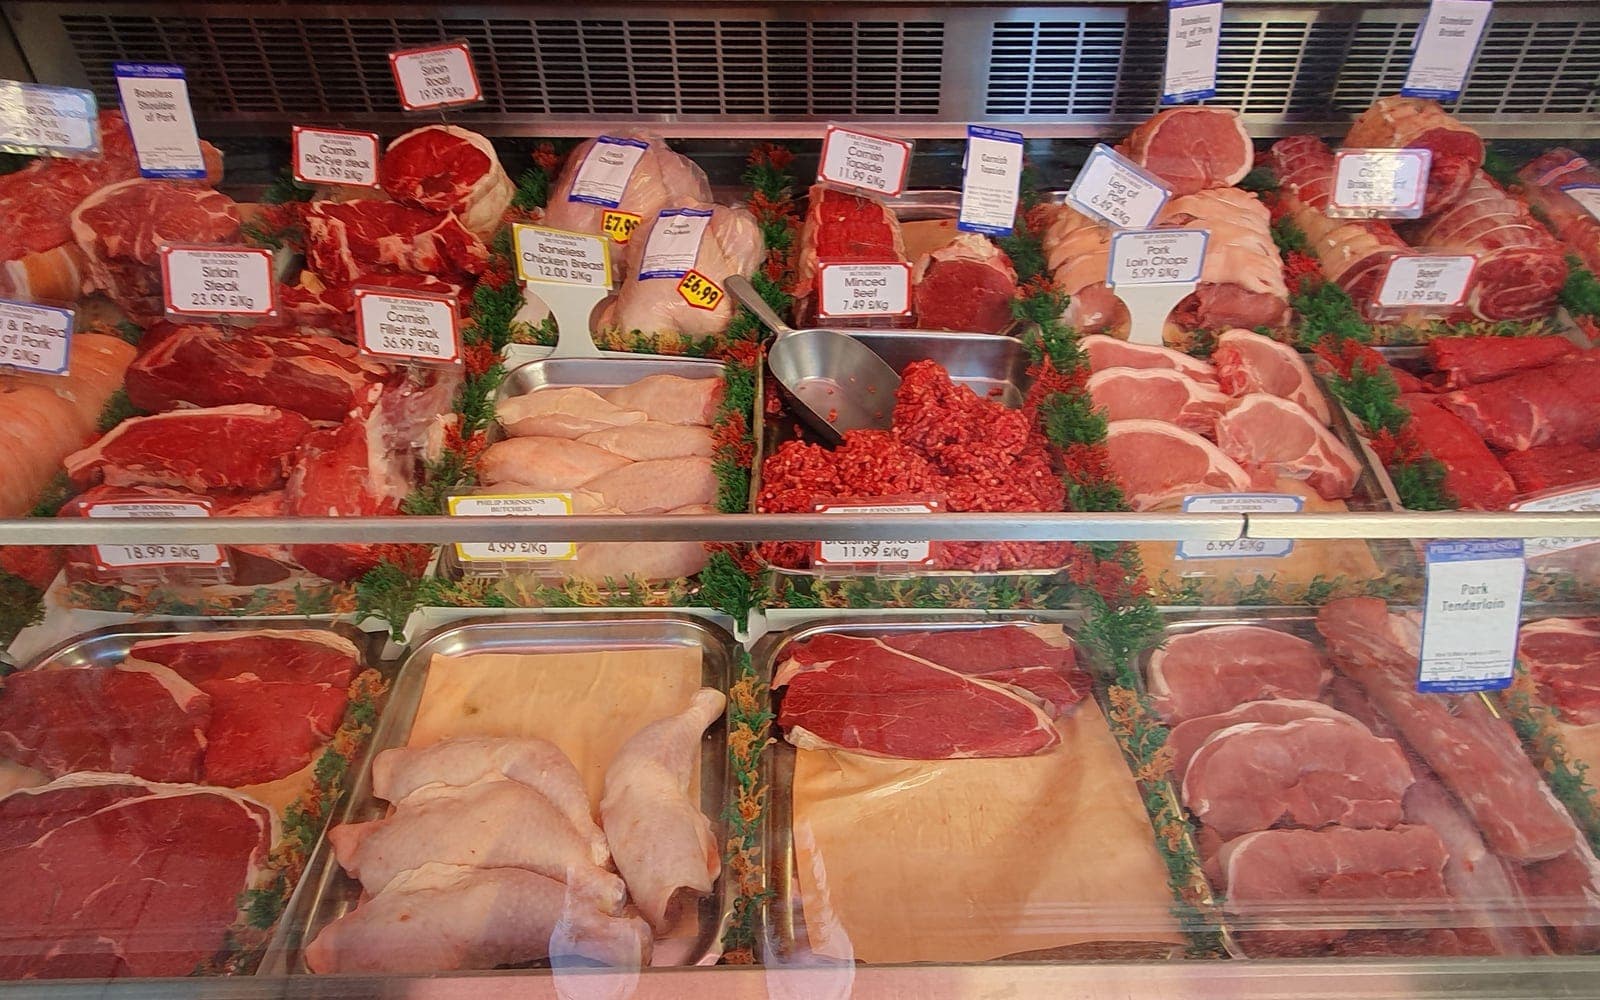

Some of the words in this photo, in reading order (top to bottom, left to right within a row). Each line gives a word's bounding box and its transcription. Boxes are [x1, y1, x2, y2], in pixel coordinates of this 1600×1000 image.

[319, 144, 356, 156] Cornish
[847, 146, 885, 163] Cornish
[315, 165, 342, 177] 21.99
[846, 156, 883, 173] Topside
[839, 166, 865, 182] 11.99
[1108, 176, 1126, 194] Leg
[538, 243, 586, 258] Boneless
[1147, 246, 1170, 255] Pork
[523, 252, 569, 267] Chicken
[571, 258, 604, 271] Breast
[1151, 256, 1188, 266] Chops
[202, 266, 239, 278] Sirloin
[539, 265, 568, 278] 12.00
[1132, 268, 1155, 279] 5.99
[204, 280, 240, 292] Steak
[844, 277, 887, 287] Minced
[682, 275, 719, 305] £6.99
[853, 288, 878, 298] Beef
[191, 292, 226, 306] 23.99
[843, 300, 865, 310] 7.49
[386, 310, 431, 325] Cornish
[379, 323, 406, 336] Fillet
[409, 327, 440, 340] steak
[21, 335, 51, 350] Pork
[383, 336, 414, 350] 36.99
[124, 546, 166, 559] 18.99
[170, 546, 200, 560] £/Kg
[488, 543, 516, 554] 4.99
[521, 543, 547, 555] £/Kg
[843, 546, 879, 557] 11.99
[883, 547, 909, 559] £/Kg
[1461, 582, 1489, 596] Pork
[1442, 598, 1506, 612] Tenderloin
